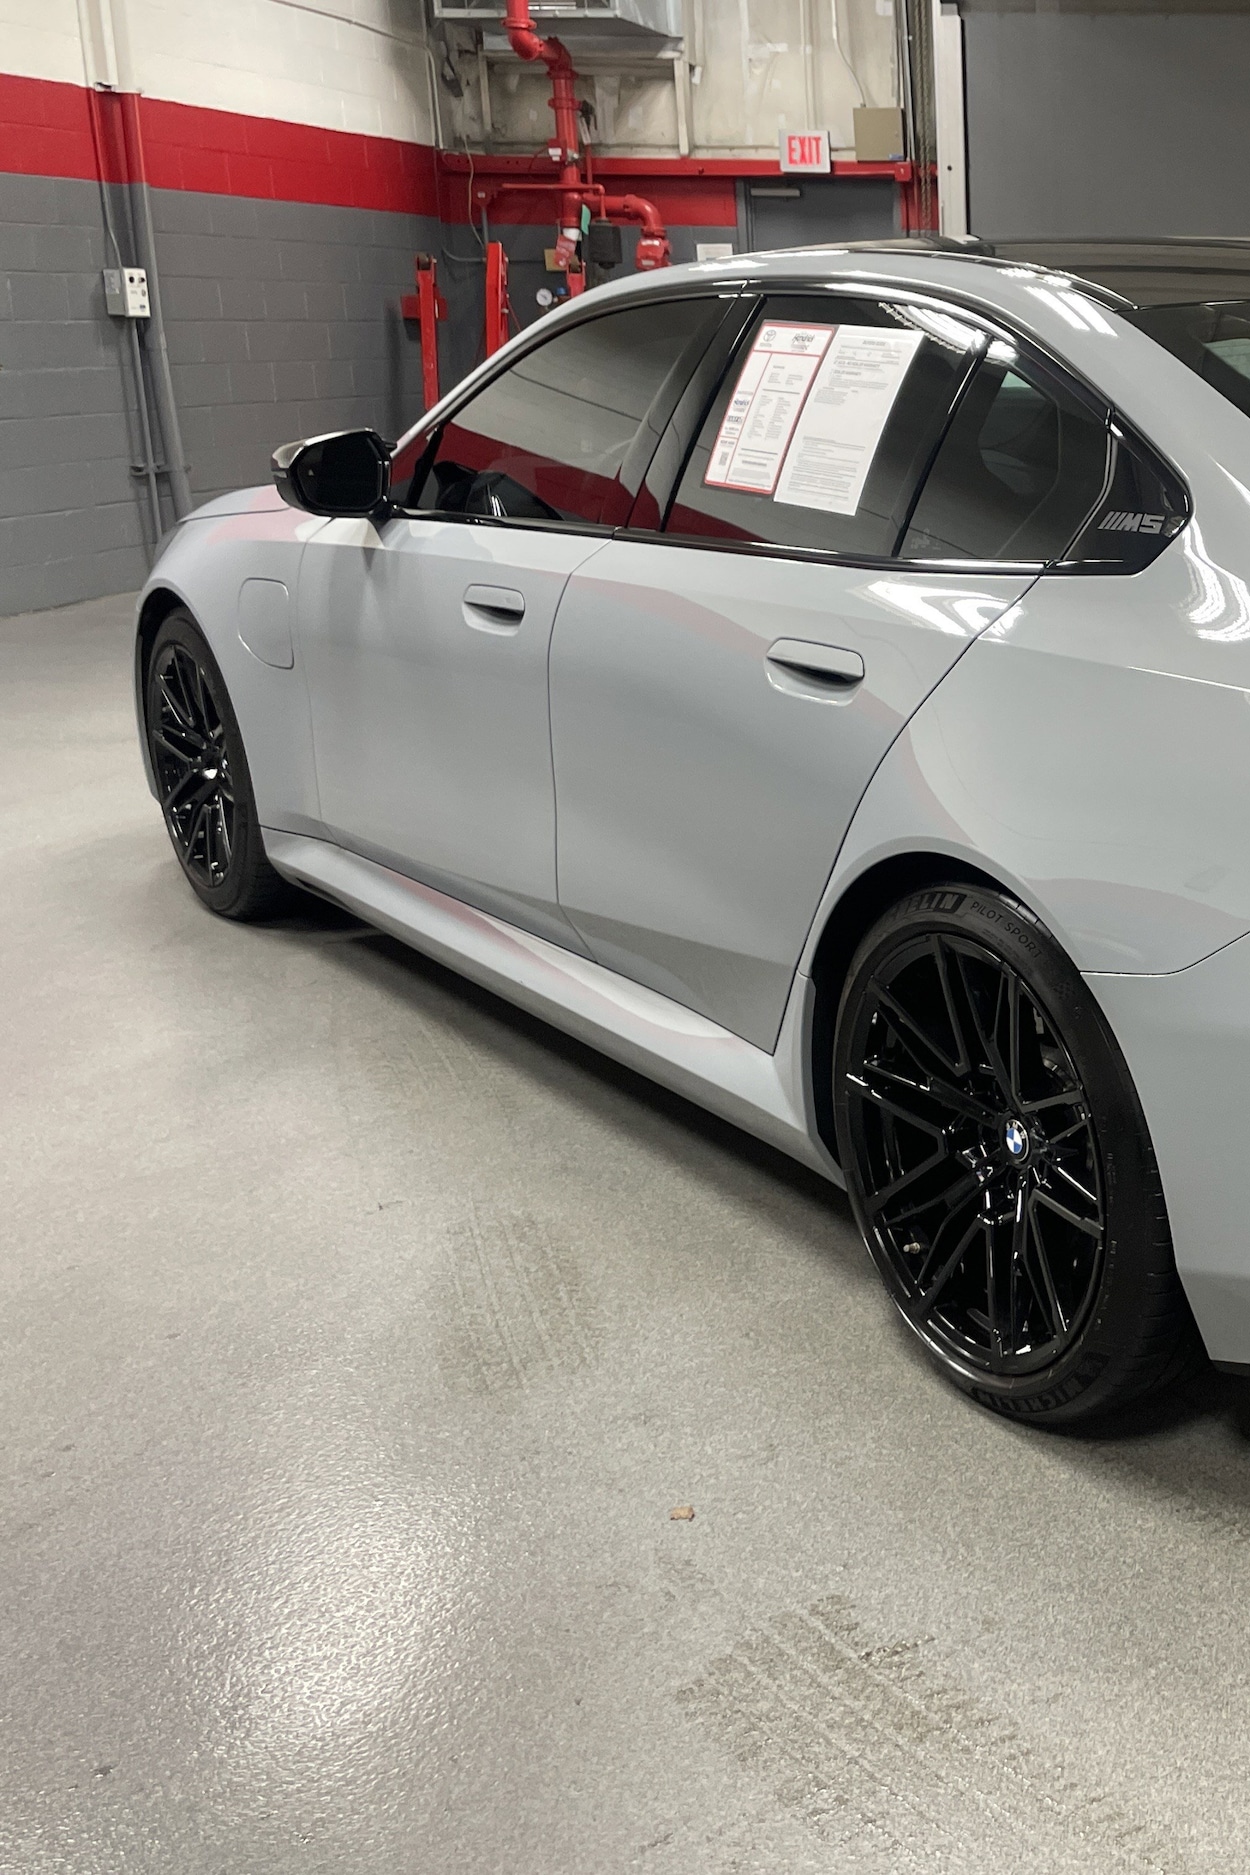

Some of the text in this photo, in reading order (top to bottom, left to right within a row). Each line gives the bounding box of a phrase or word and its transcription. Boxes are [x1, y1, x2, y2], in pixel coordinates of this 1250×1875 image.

[788, 135, 821, 165] EXIT
[970, 901, 1004, 923] PILOT
[1004, 922, 1042, 958] SPORT
